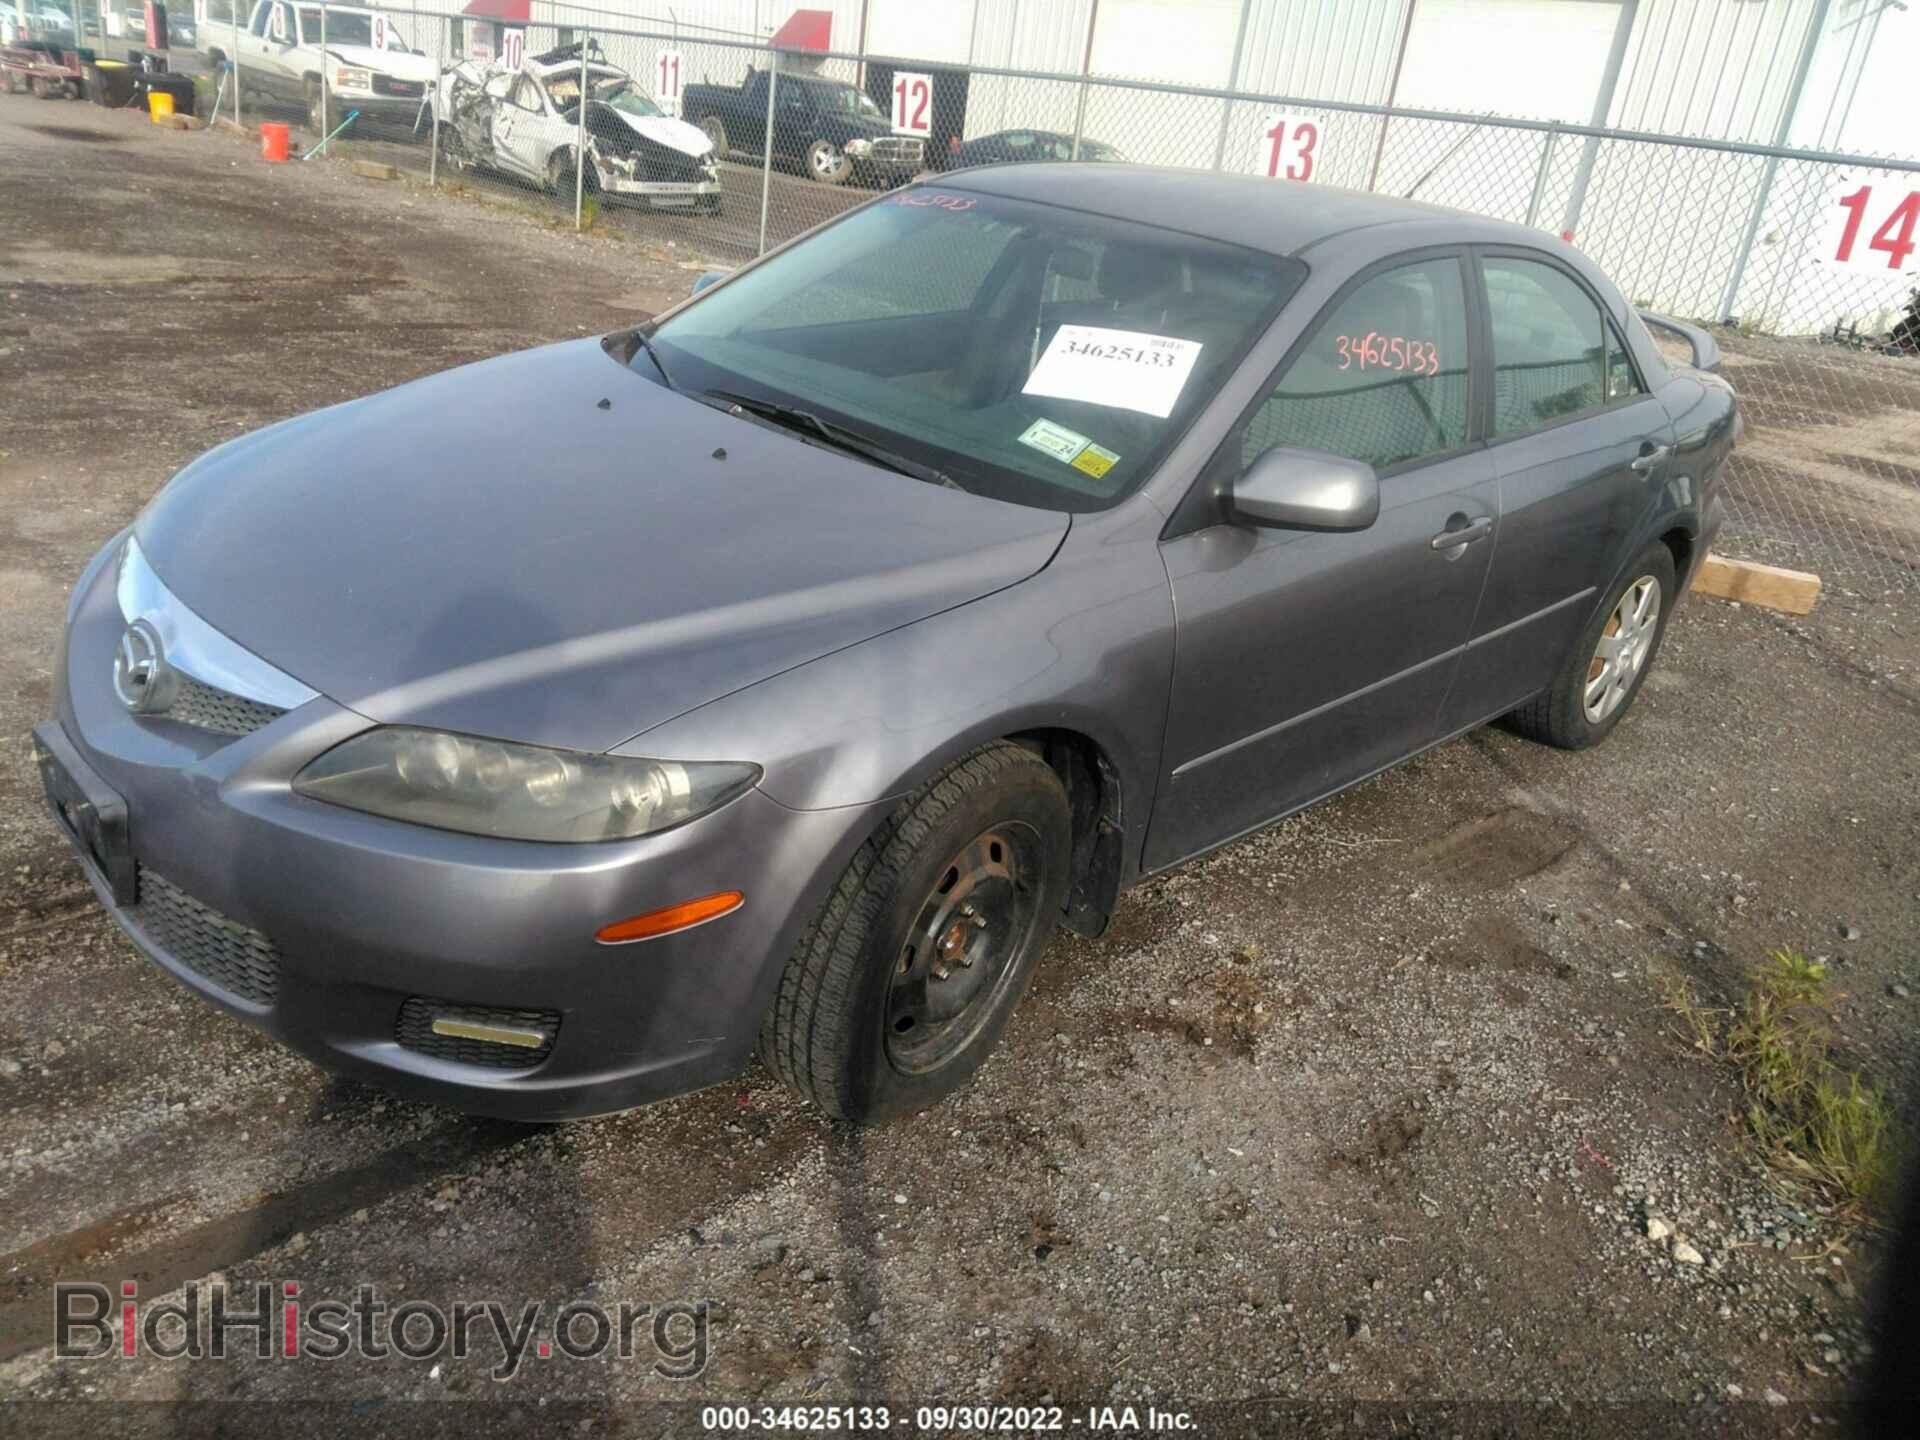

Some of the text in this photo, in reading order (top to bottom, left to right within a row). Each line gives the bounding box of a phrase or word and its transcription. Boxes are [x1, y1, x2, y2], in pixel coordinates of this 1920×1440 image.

[375, 17, 385, 49] 9
[503, 33, 523, 72] 10
[659, 54, 680, 97] 11
[895, 78, 929, 130] 12
[1265, 119, 1318, 182] 13
[1834, 184, 1920, 270] 14
[1059, 339, 1176, 369] 34625133
[1335, 331, 1440, 376] 34625133
